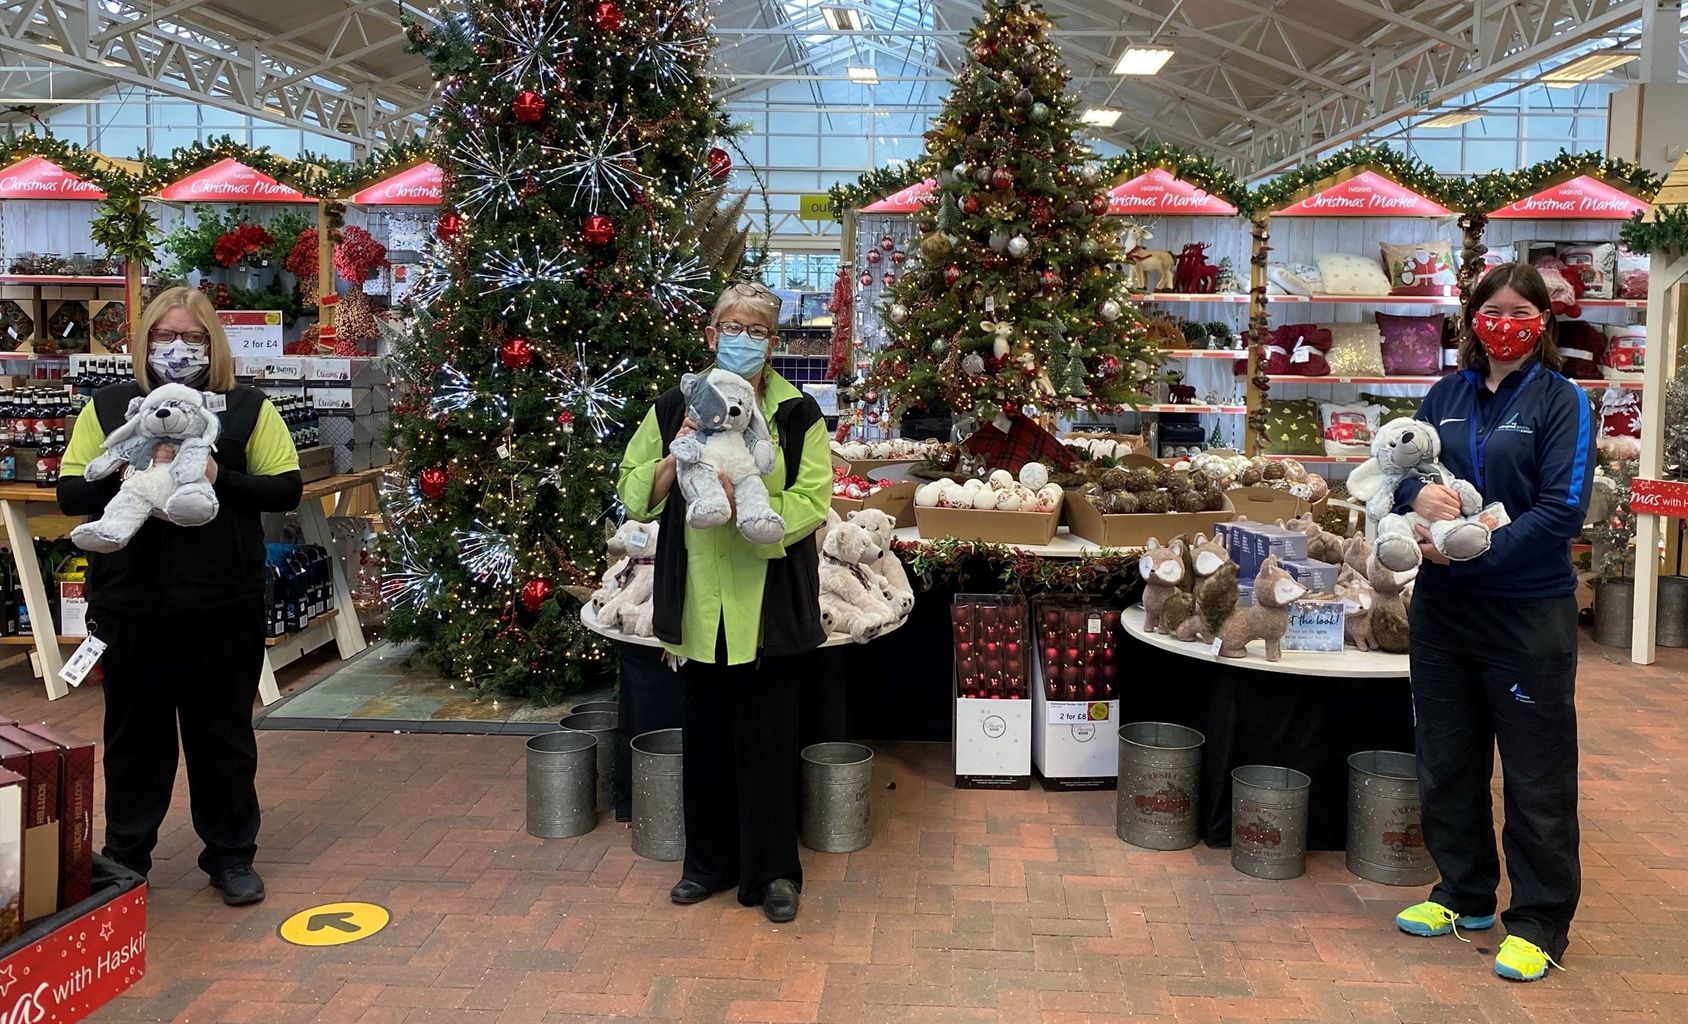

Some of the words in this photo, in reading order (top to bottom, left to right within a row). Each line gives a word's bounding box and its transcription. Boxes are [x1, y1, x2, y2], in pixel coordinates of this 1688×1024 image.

[0, 176, 58, 192] Christmas
[191, 179, 249, 194] Christmas
[1108, 194, 1158, 208] hristmas
[1161, 192, 1210, 208] Market
[1302, 193, 1365, 209] Christmas
[1368, 193, 1418, 209] Market
[1512, 196, 1575, 212] Christmas
[1579, 196, 1631, 211] Market
[243, 340, 249, 348] 2
[252, 340, 264, 349] for
[266, 340, 278, 348] £4
[1662, 498, 1682, 507] with
[1299, 614, 1314, 626] the
[1316, 614, 1340, 625] look!
[1066, 712, 1075, 720] for
[0, 982, 49, 1024] as
[53, 966, 92, 1004] with
